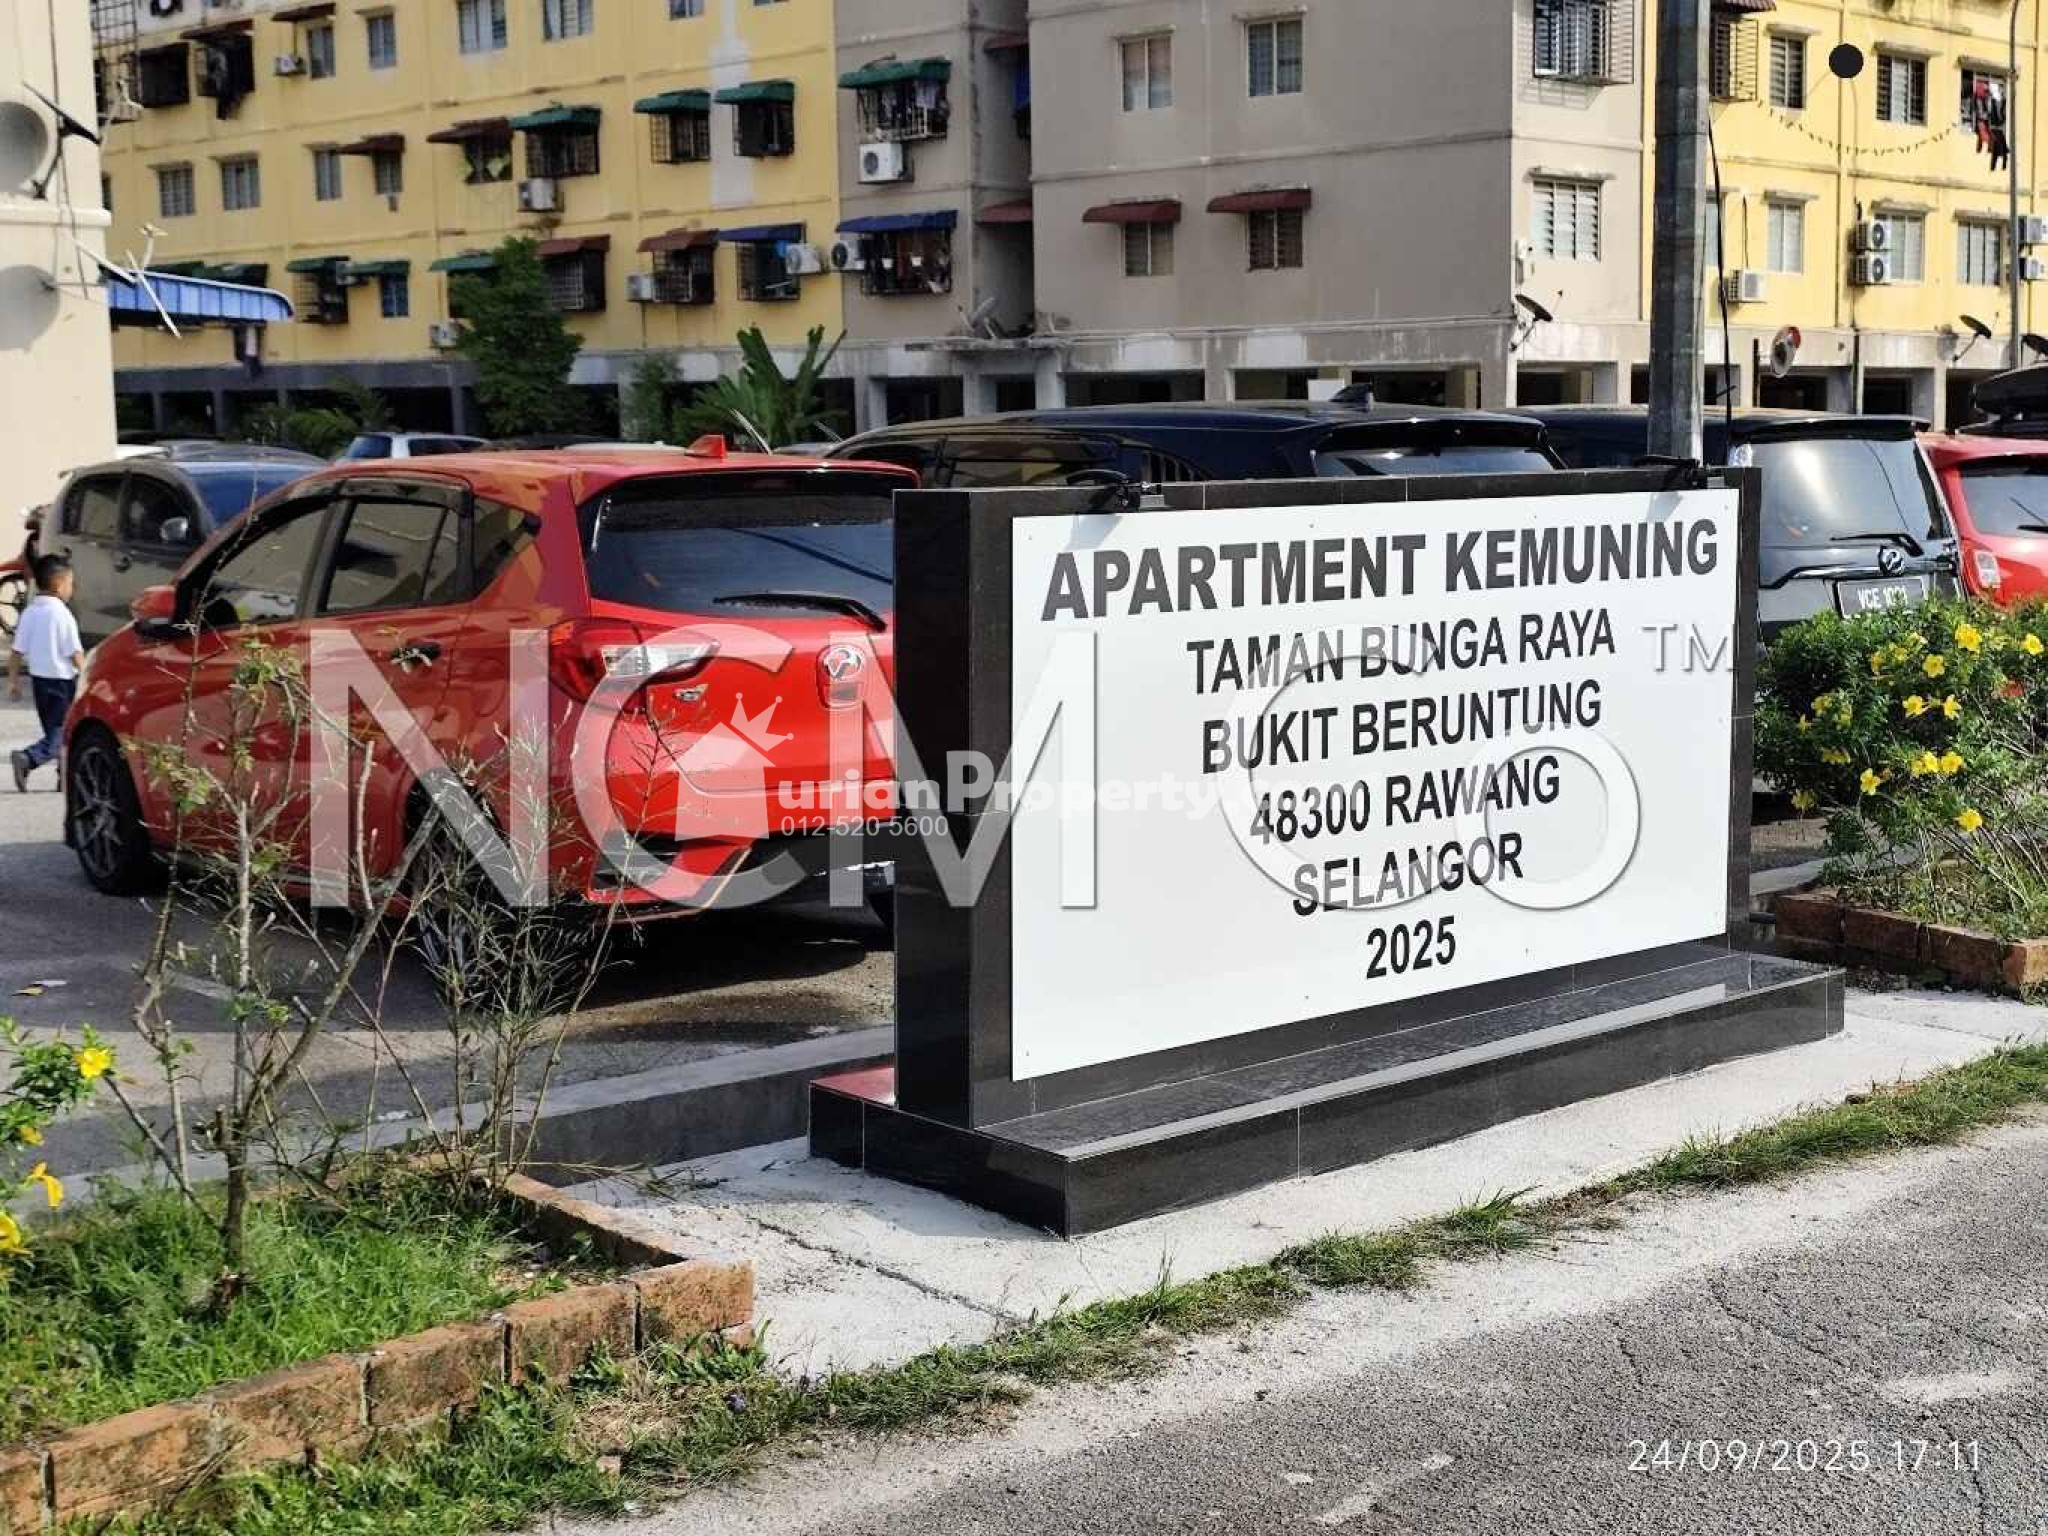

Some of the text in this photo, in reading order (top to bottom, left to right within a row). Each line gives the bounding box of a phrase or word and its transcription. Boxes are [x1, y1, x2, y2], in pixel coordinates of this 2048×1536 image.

[1041, 519, 1719, 622] APARTMENT KEMUNING
[1187, 608, 1616, 695] TAMAN BUNGA RAYA
[1203, 679, 1603, 775] BUKIT BERUNTUNG
[1249, 756, 1561, 846] 48300 RAWANG
[1293, 833, 1524, 917] SELANGOR
[1366, 915, 1457, 979] 2025
